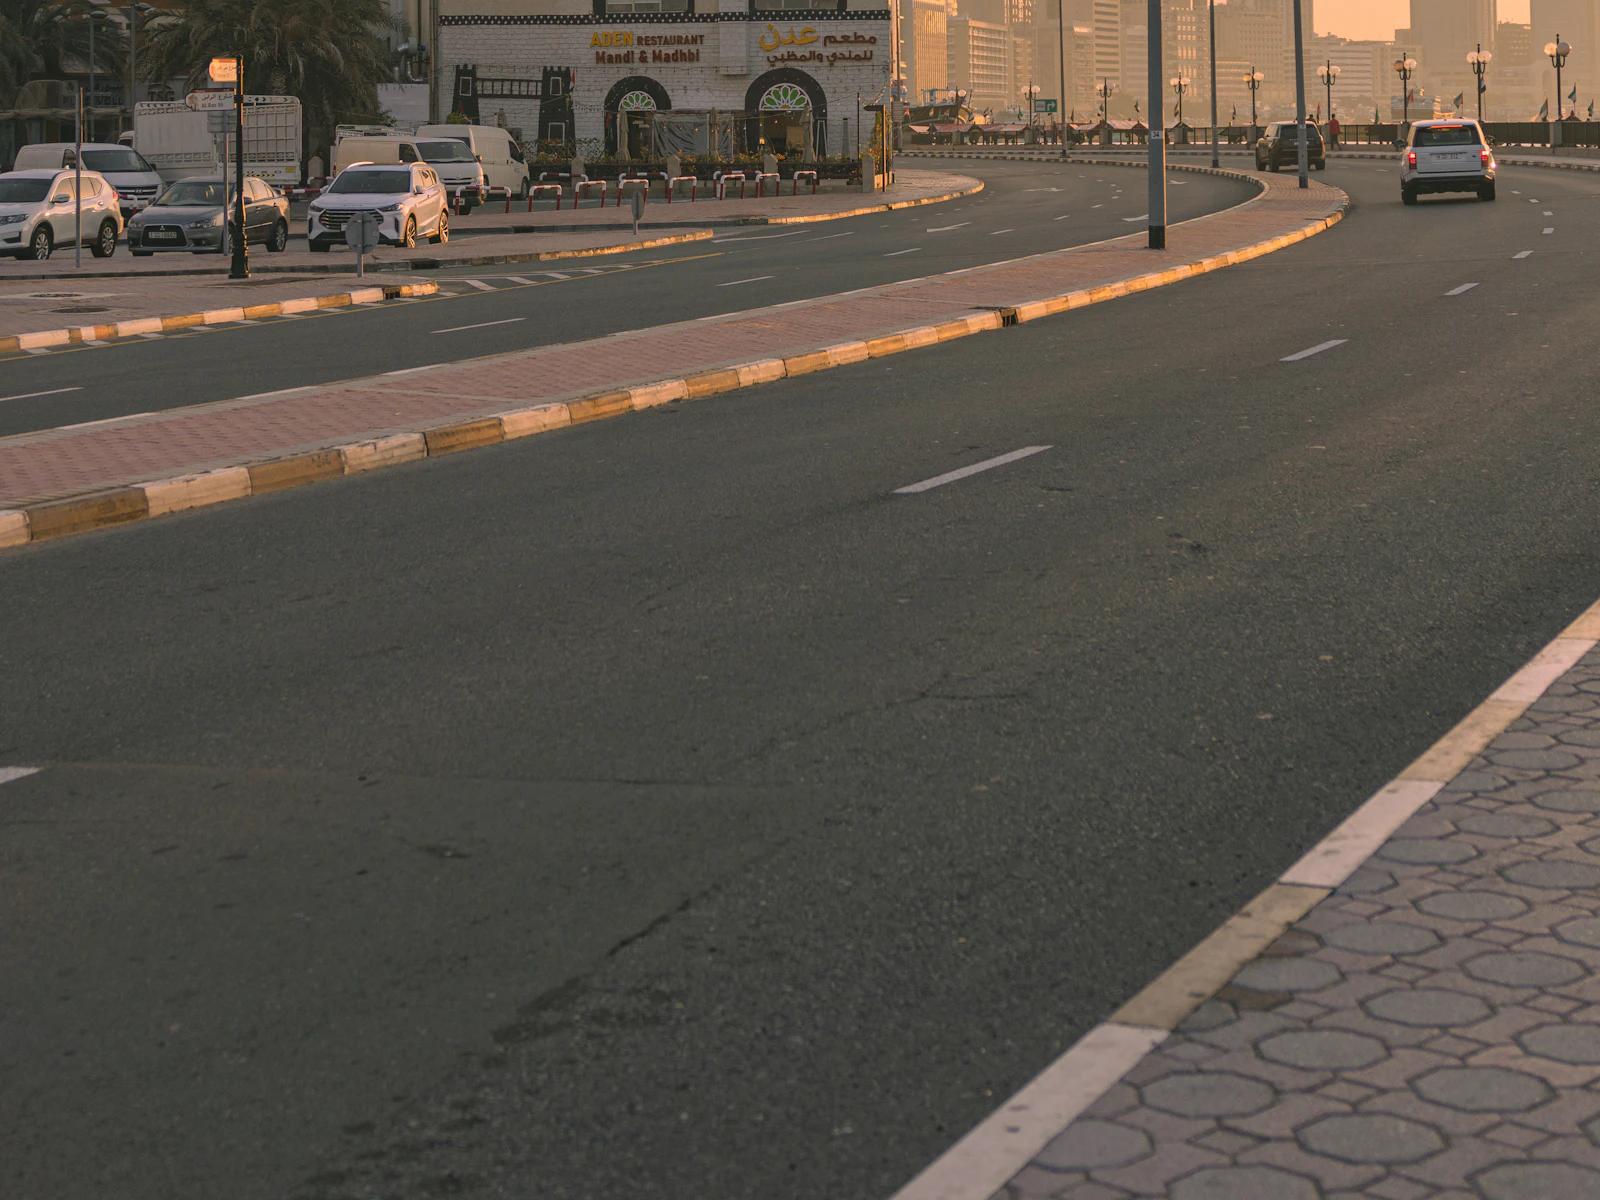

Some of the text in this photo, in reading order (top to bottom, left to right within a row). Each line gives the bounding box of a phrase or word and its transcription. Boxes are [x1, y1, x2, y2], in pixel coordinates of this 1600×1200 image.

[590, 31, 705, 47] ADEN RESTAURANT
[759, 23, 877, 51] مطعم عدن
[595, 49, 700, 64] Mandi & Madhbi
[826, 50, 873, 66] للمندي
